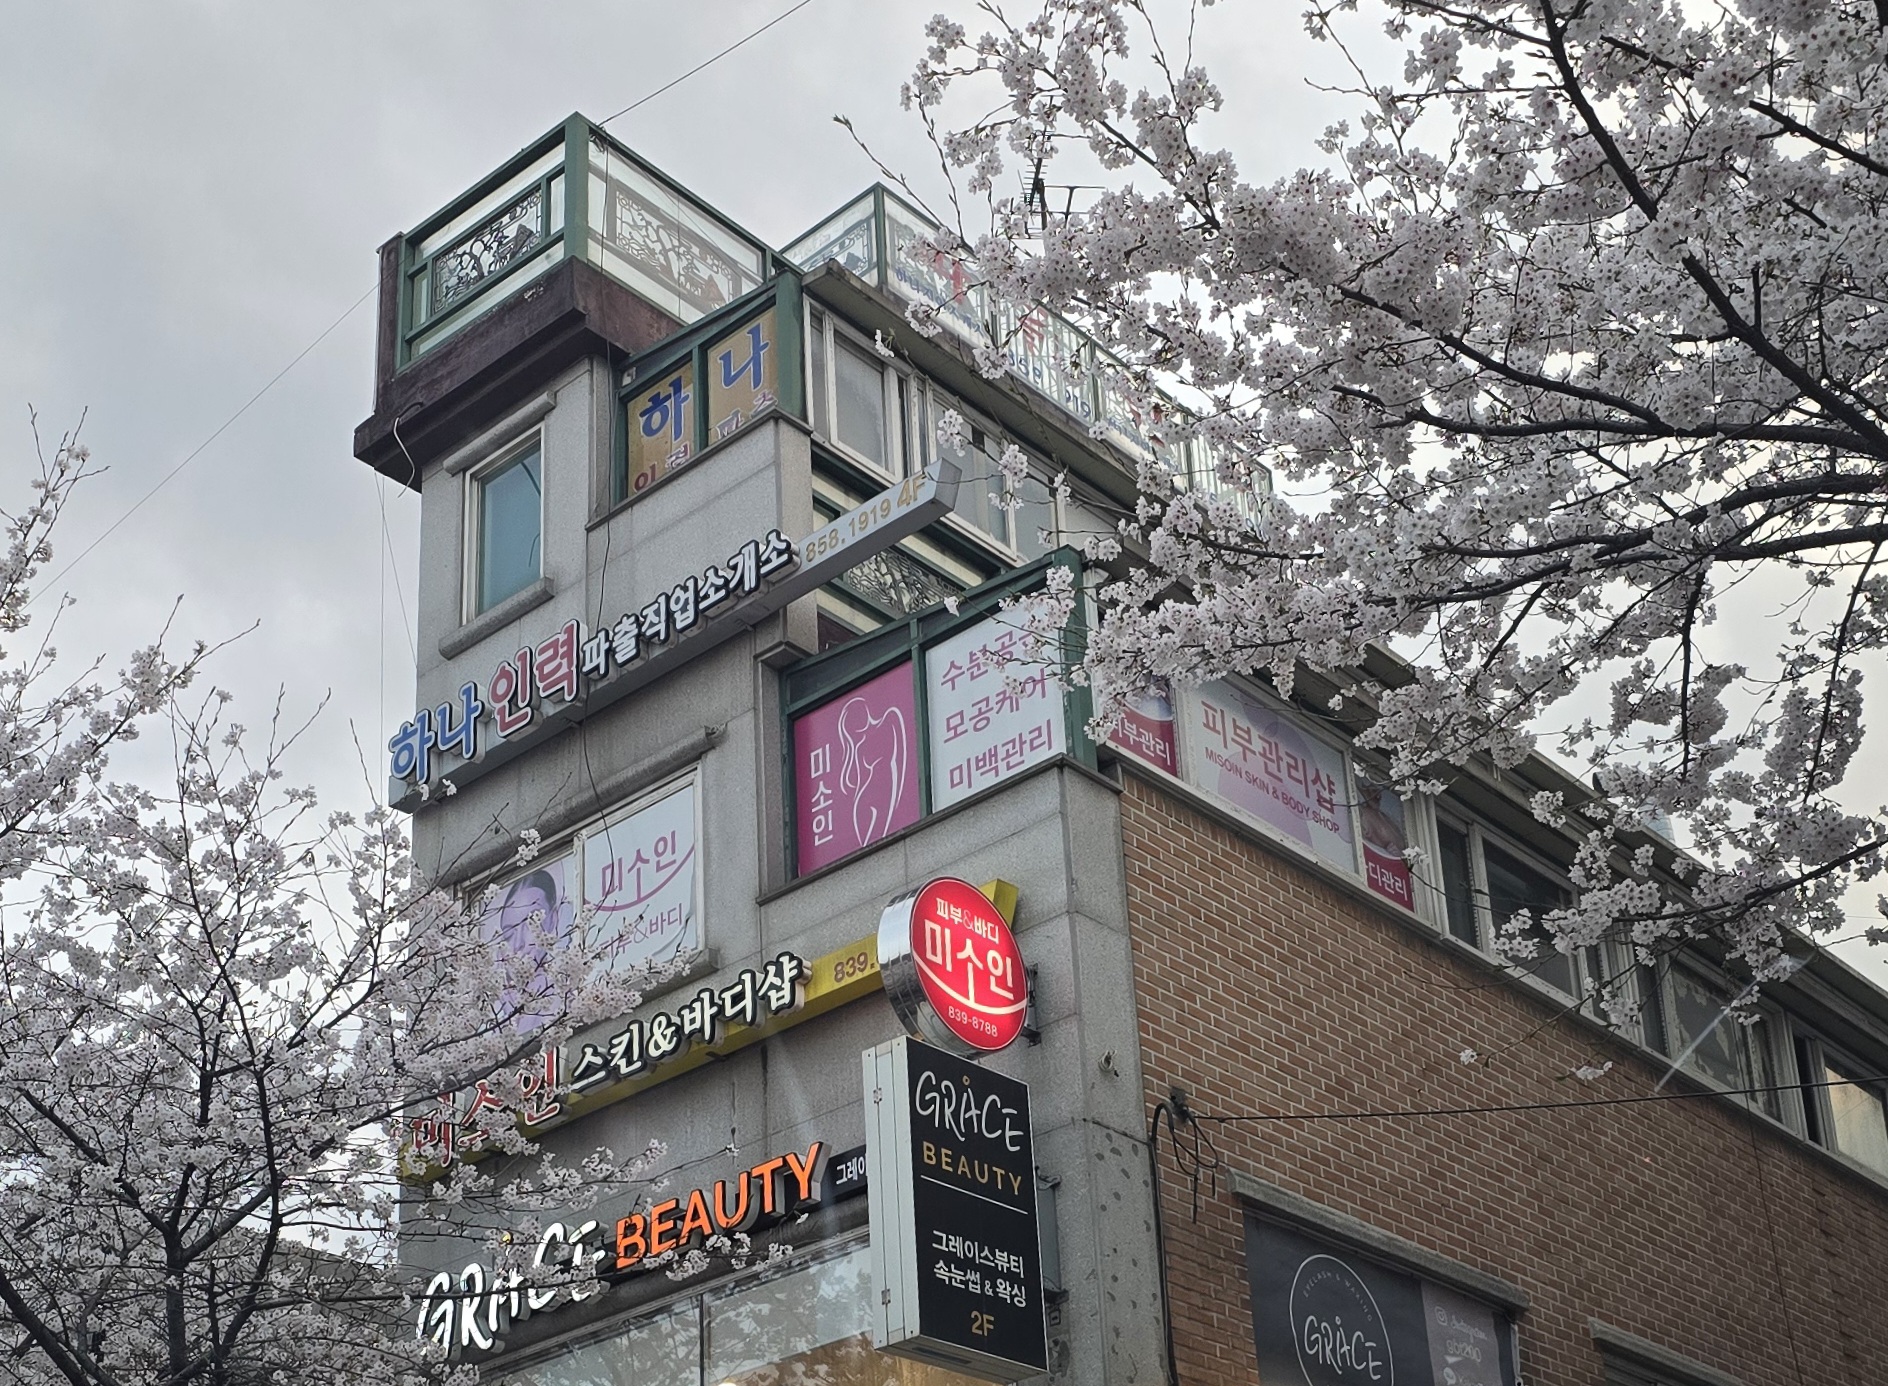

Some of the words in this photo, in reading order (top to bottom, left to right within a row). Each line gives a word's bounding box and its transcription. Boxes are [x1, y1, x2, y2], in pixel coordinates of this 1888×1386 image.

[388, 681, 484, 784] 하나
[489, 620, 583, 738] 인력
[580, 530, 795, 680] 파출직업소개소
[896, 472, 929, 509] 4F
[948, 720, 1053, 790] 미백관리
[1201, 700, 1337, 815] 피부관리샵
[1204, 746, 1243, 783] MISOIN
[1244, 770, 1270, 796] SKIN
[1280, 792, 1310, 818] BODY
[1311, 809, 1340, 834] SHOP
[809, 743, 834, 847] 미소인
[600, 830, 679, 902] 미소인
[1366, 861, 1408, 901] 디관리
[935, 897, 1000, 945] 피부&바디
[924, 919, 1015, 1003] 미소인
[570, 951, 806, 1092] 스킨&바디샵
[948, 1005, 999, 1038] 839-8788
[915, 1071, 1024, 1152] GRACE
[921, 1141, 1023, 1197] BEAUTY
[615, 1141, 824, 1270] BEAUTY
[931, 1229, 1025, 1279] 그레이스뷰티
[933, 1259, 982, 1295] 속눈썹
[983, 1280, 995, 1298] &
[995, 1278, 1028, 1309] 왁싱
[970, 1310, 995, 1336] 2F
[1303, 1315, 1383, 1380] GRACE
